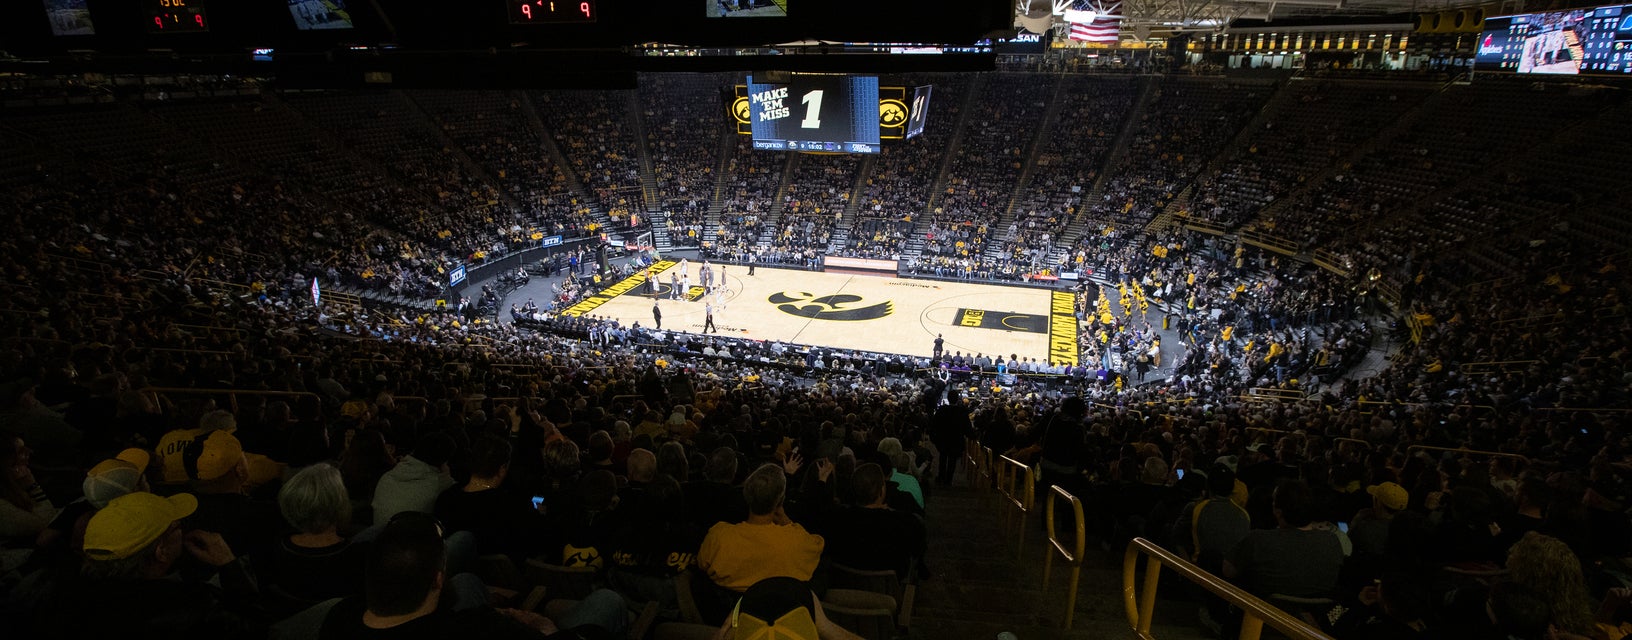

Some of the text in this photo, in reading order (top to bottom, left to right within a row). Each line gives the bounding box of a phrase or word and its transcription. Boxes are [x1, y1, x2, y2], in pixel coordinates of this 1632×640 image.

[522, 1, 590, 19] 9 1 9
[154, 16, 163, 29] 9
[194, 14, 204, 27] 9
[751, 87, 789, 104] MAKE
[761, 98, 784, 111] 'EM
[801, 89, 824, 129] 1
[759, 107, 790, 122] MISS
[1050, 314, 1079, 367] HAWKEYE
[161, 440, 194, 458] IOW
